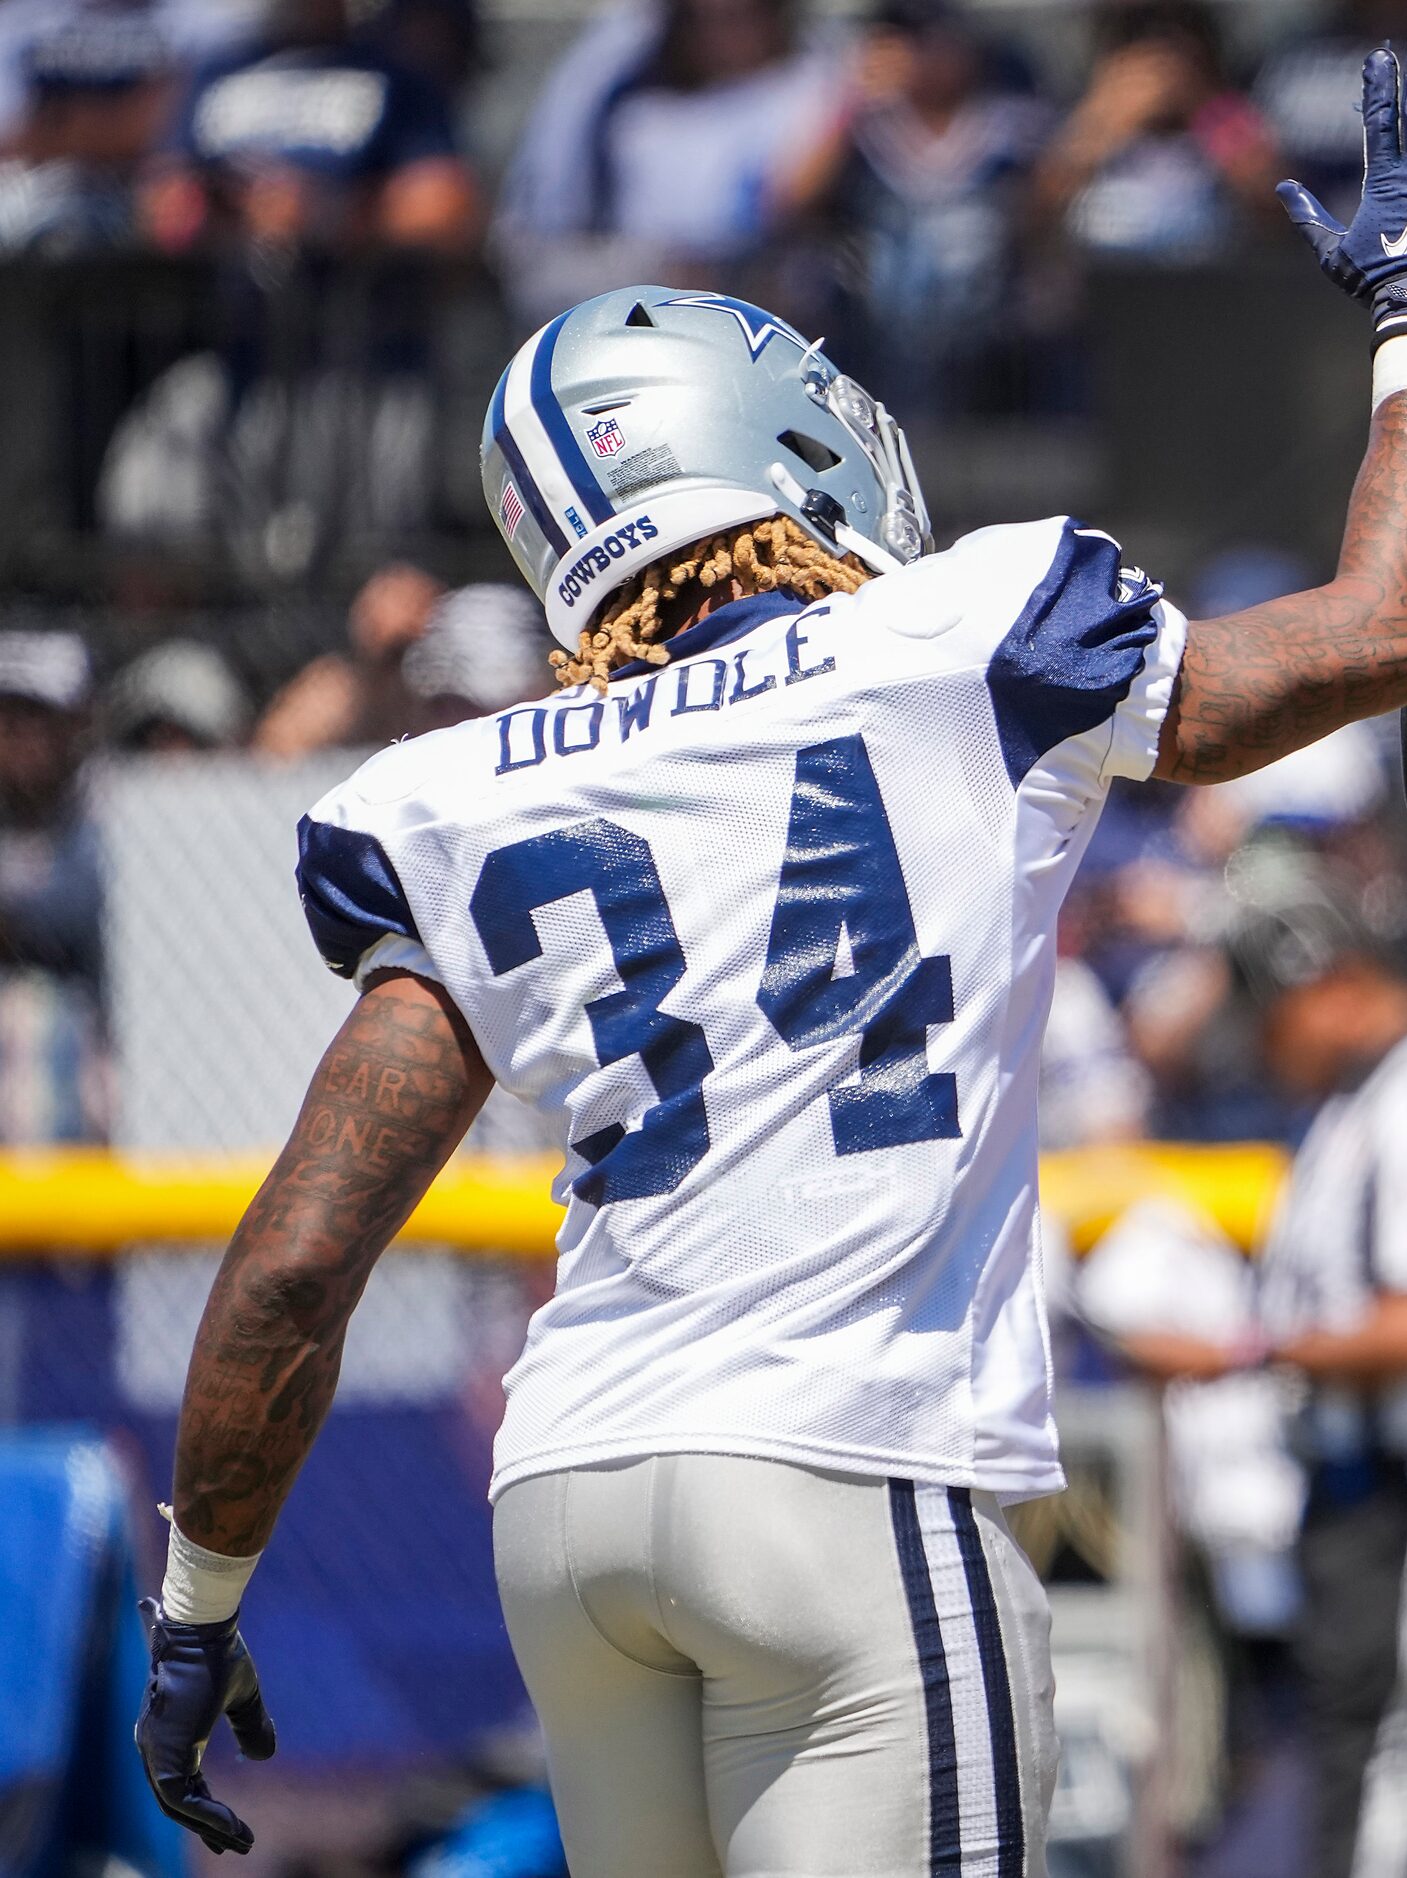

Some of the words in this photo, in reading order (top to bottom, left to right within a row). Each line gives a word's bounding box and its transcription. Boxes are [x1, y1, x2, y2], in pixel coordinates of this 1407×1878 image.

[595, 432, 623, 455] NFL
[559, 515, 659, 608] COWBOYS
[494, 605, 836, 777] DOWDLE
[469, 732, 963, 1210] 34
